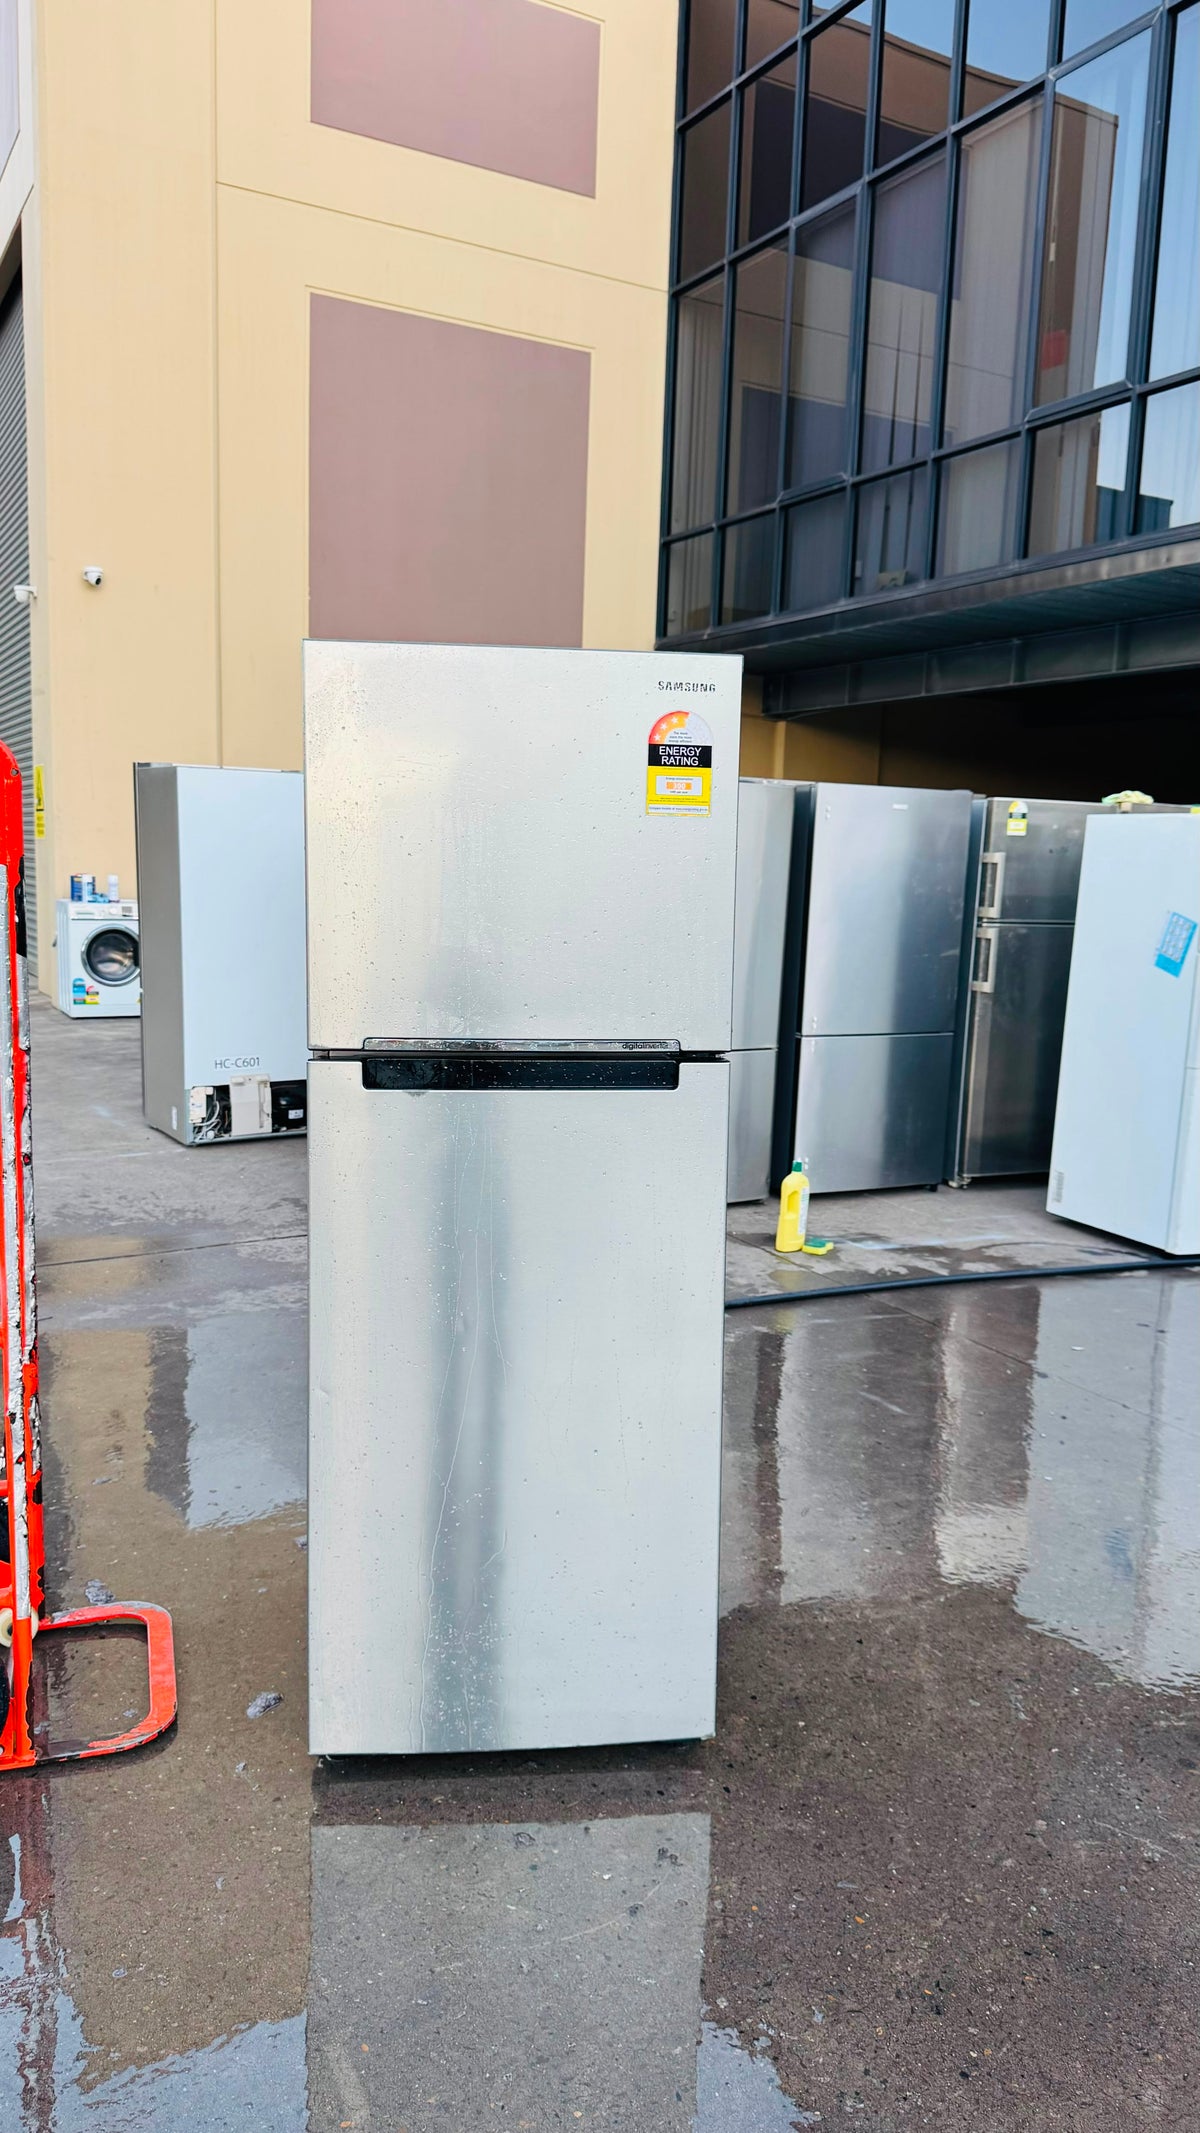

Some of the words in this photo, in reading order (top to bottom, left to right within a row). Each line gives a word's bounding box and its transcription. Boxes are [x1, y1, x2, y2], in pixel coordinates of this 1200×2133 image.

[658, 680, 716, 692] SAMSUNG
[659, 746, 701, 756] ENERGY
[661, 755, 699, 766] RATING
[215, 1057, 260, 1069] HC-C601
